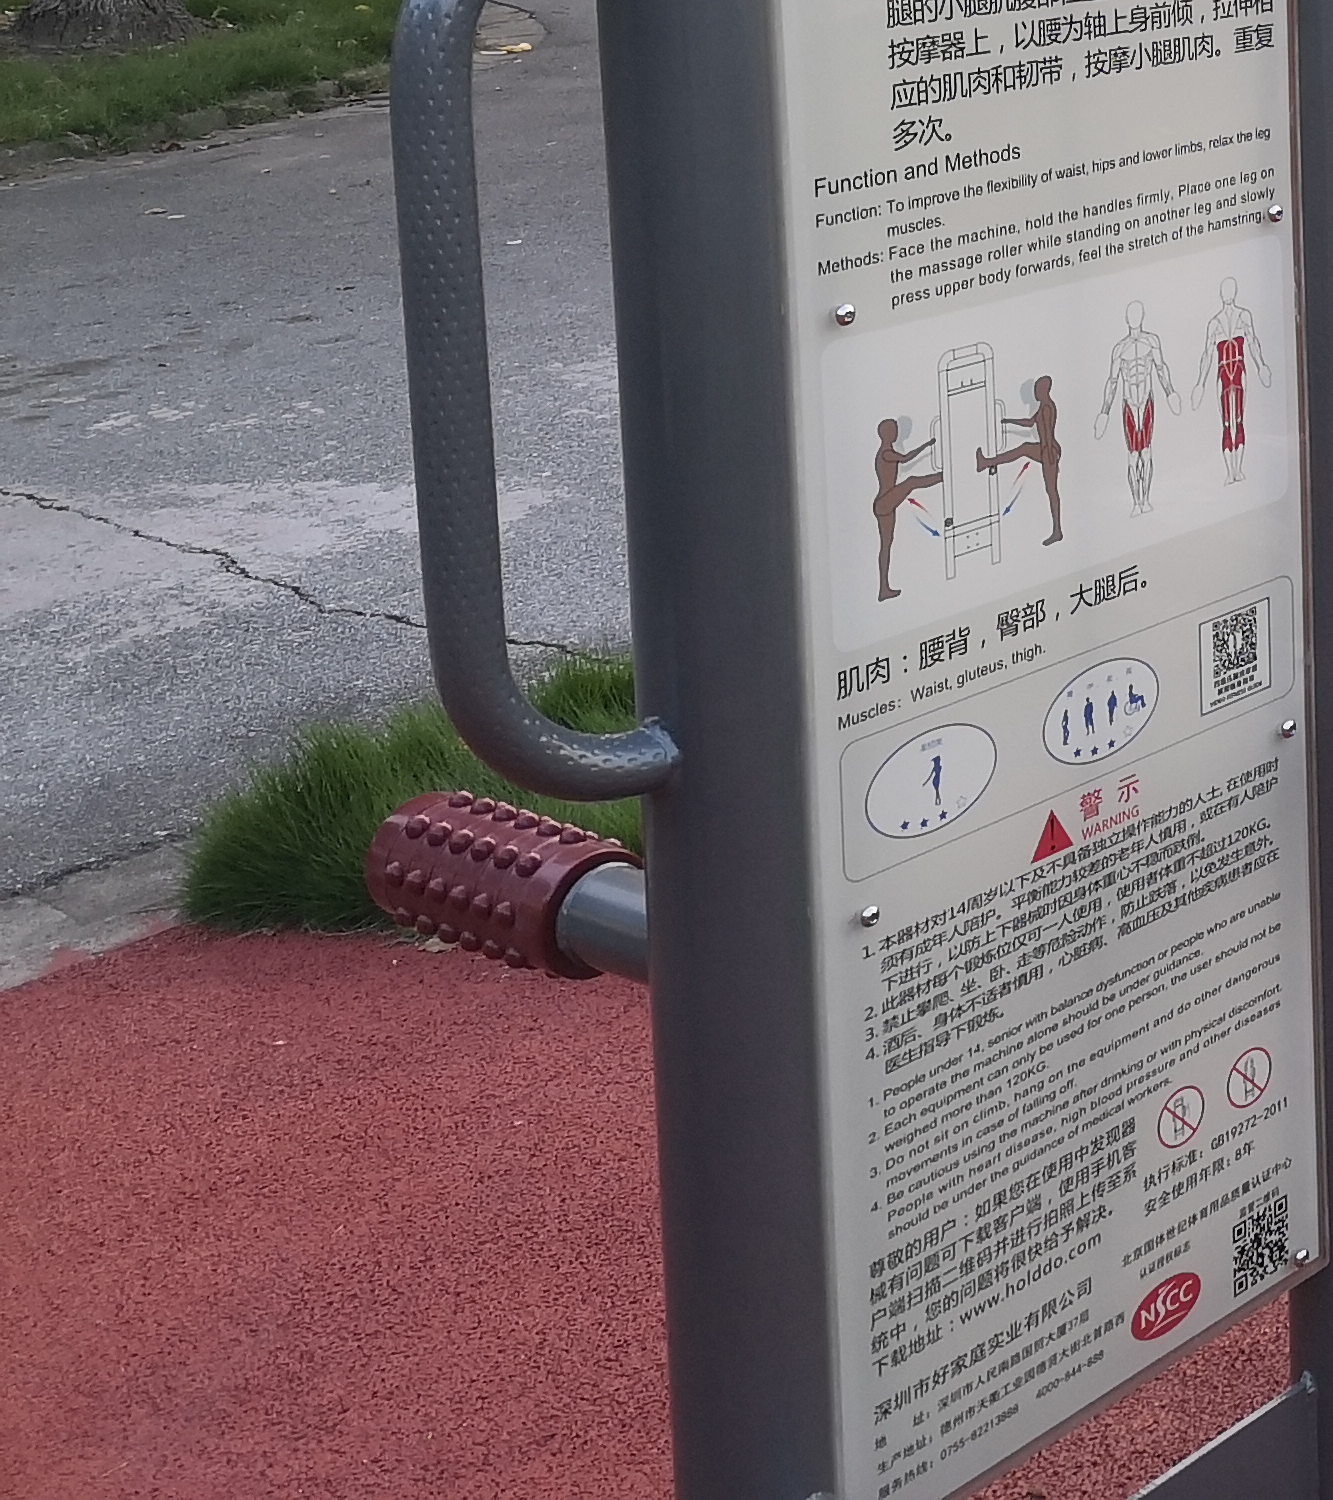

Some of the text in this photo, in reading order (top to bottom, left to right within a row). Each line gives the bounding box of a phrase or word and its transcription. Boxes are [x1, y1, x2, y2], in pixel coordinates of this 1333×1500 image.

[814, 143, 1021, 198] Function and Methods
[815, 127, 1271, 229] Function: To improve the flexibility of waist, hips and lower limbs, relax the leg
[892, 114, 952, 152] 多次。
[817, 250, 884, 277] Methods:
[888, 243, 925, 261] Face
[930, 236, 953, 252] the
[957, 223, 1021, 246] machine,
[1025, 212, 1054, 232] hold
[1057, 209, 1079, 224] the
[1082, 198, 1133, 219] handles
[1178, 181, 1212, 198] Place
[1214, 176, 1237, 190] one
[1239, 171, 1258, 185] leg
[1260, 167, 1275, 180] on
[886, 216, 946, 238] muscles.
[890, 186, 1276, 284] the massage roller while standing on another leg and slowly
[891, 211, 1267, 311] press upper body forwards, feel the stretch of the hamstring.
[837, 643, 1046, 731] Muscles: Waist, gluteus, thigh.
[1081, 804, 1140, 841] WARNING
[882, 1072, 927, 1102] People
[928, 1052, 965, 1079] under
[966, 1042, 985, 1059] 14,
[986, 1022, 1024, 1049] senior
[1024, 1011, 1049, 1030] with
[1050, 987, 1094, 1017] balance
[1095, 955, 1156, 994] dysfunction
[1156, 948, 1169, 962] or
[1169, 931, 1205, 958] people
[1206, 919, 1228, 936] who
[1229, 909, 1246, 925] are
[1247, 891, 1282, 915] unable
[884, 1112, 917, 1137] Each
[919, 1075, 985, 1118] equipment
[986, 1064, 1009, 1083] can
[1010, 1049, 1037, 1071] only
[1056, 1022, 1085, 1047] used
[1086, 1014, 1103, 1031] for
[1128, 983, 1169, 1013] person,
[1170, 971, 1188, 987] the
[1189, 957, 1213, 977] user
[1214, 937, 1249, 964] should
[1250, 927, 1267, 945] not
[885, 1154, 905, 1171] Do
[908, 1138, 930, 1160] not
[933, 1128, 950, 1146] sit
[952, 1119, 970, 1136] on
[972, 1100, 1011, 1124] climb,
[1013, 1079, 1045, 1103] hang
[1047, 1068, 1064, 1084] on
[1066, 1057, 1086, 1075] the
[1088, 1021, 1150, 1062] equipment
[1152, 1007, 1174, 1029] and
[1176, 1001, 1192, 1016] do
[1193, 983, 1223, 1006] other
[1225, 953, 1281, 990] dangerous
[907, 1158, 961, 1194] cautious
[962, 1139, 996, 1165] using
[998, 1127, 1018, 1144] the
[1020, 1099, 1070, 1134] machine
[1072, 1082, 1099, 1105] after
[1100, 1058, 1144, 1089] drinking
[1145, 1050, 1158, 1064] or
[1159, 1038, 1182, 1057] with
[1184, 1011, 1227, 1047] physical
